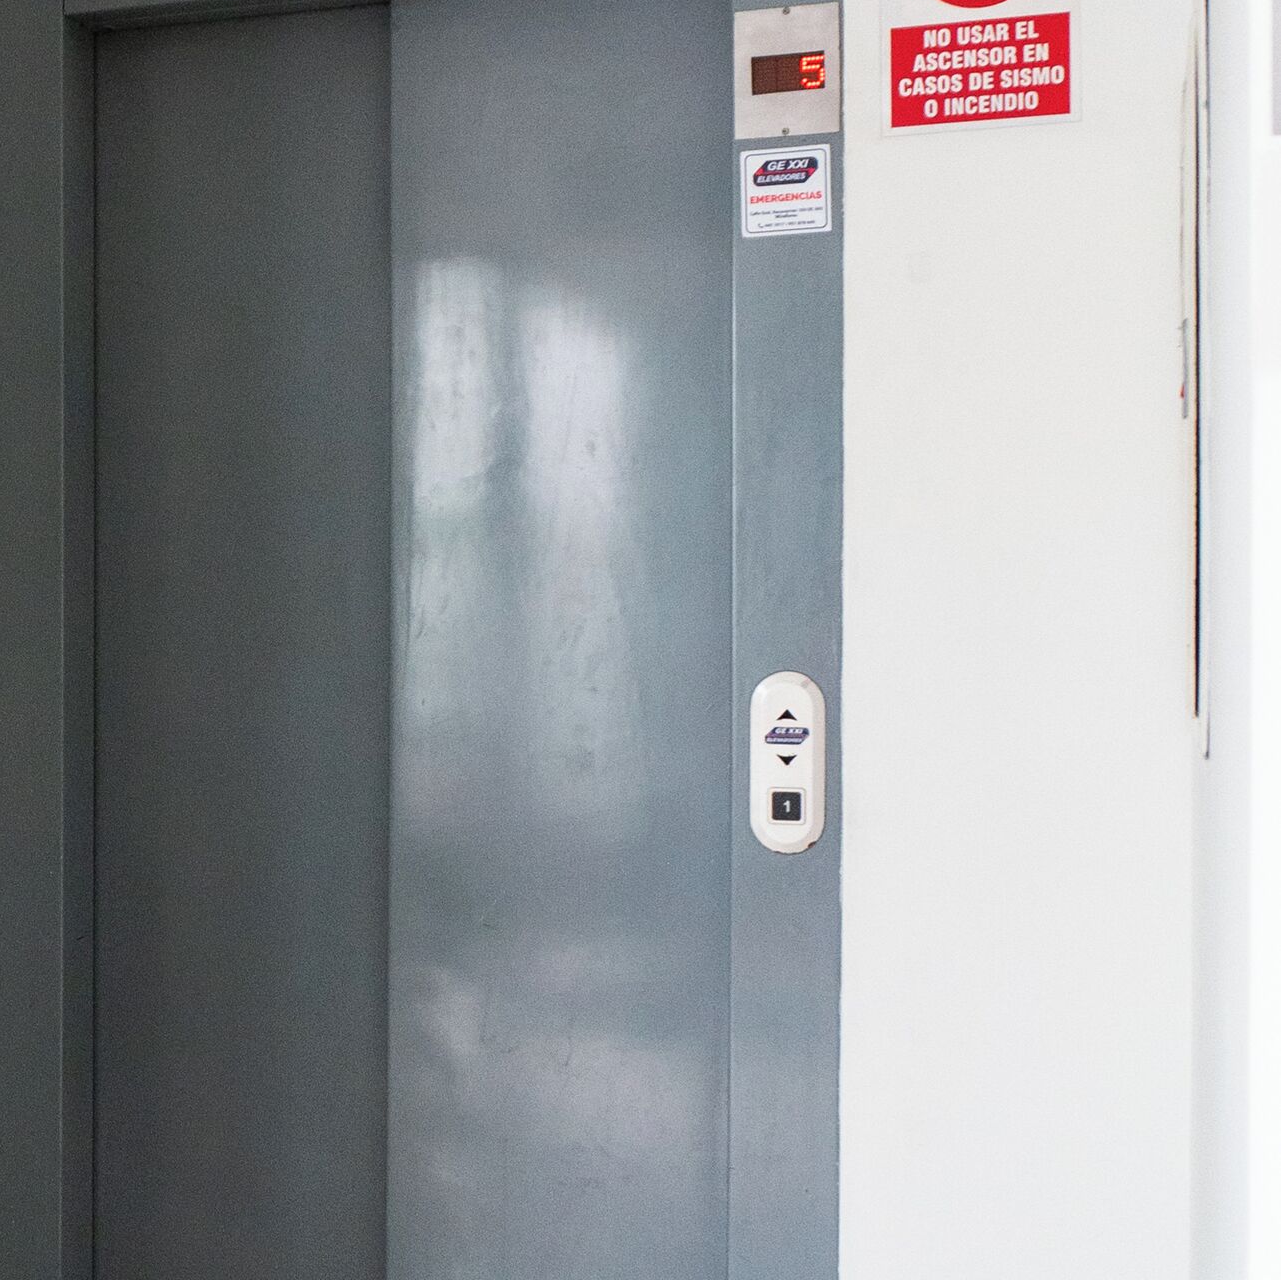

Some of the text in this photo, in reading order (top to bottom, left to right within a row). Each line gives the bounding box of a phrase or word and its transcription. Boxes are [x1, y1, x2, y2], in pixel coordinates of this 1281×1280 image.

[923, 20, 1039, 49] NO USAR EL
[800, 53, 826, 88] 5
[912, 43, 1050, 72] ASCENSOR EN
[898, 65, 1065, 97] CASOS DE SISMO
[924, 91, 1039, 118] O INCENDIO
[756, 172, 807, 184] ELEVADORES
[767, 158, 810, 171] GE XXI
[750, 191, 823, 204] EMERGENCIAS
[782, 800, 791, 813] 1
